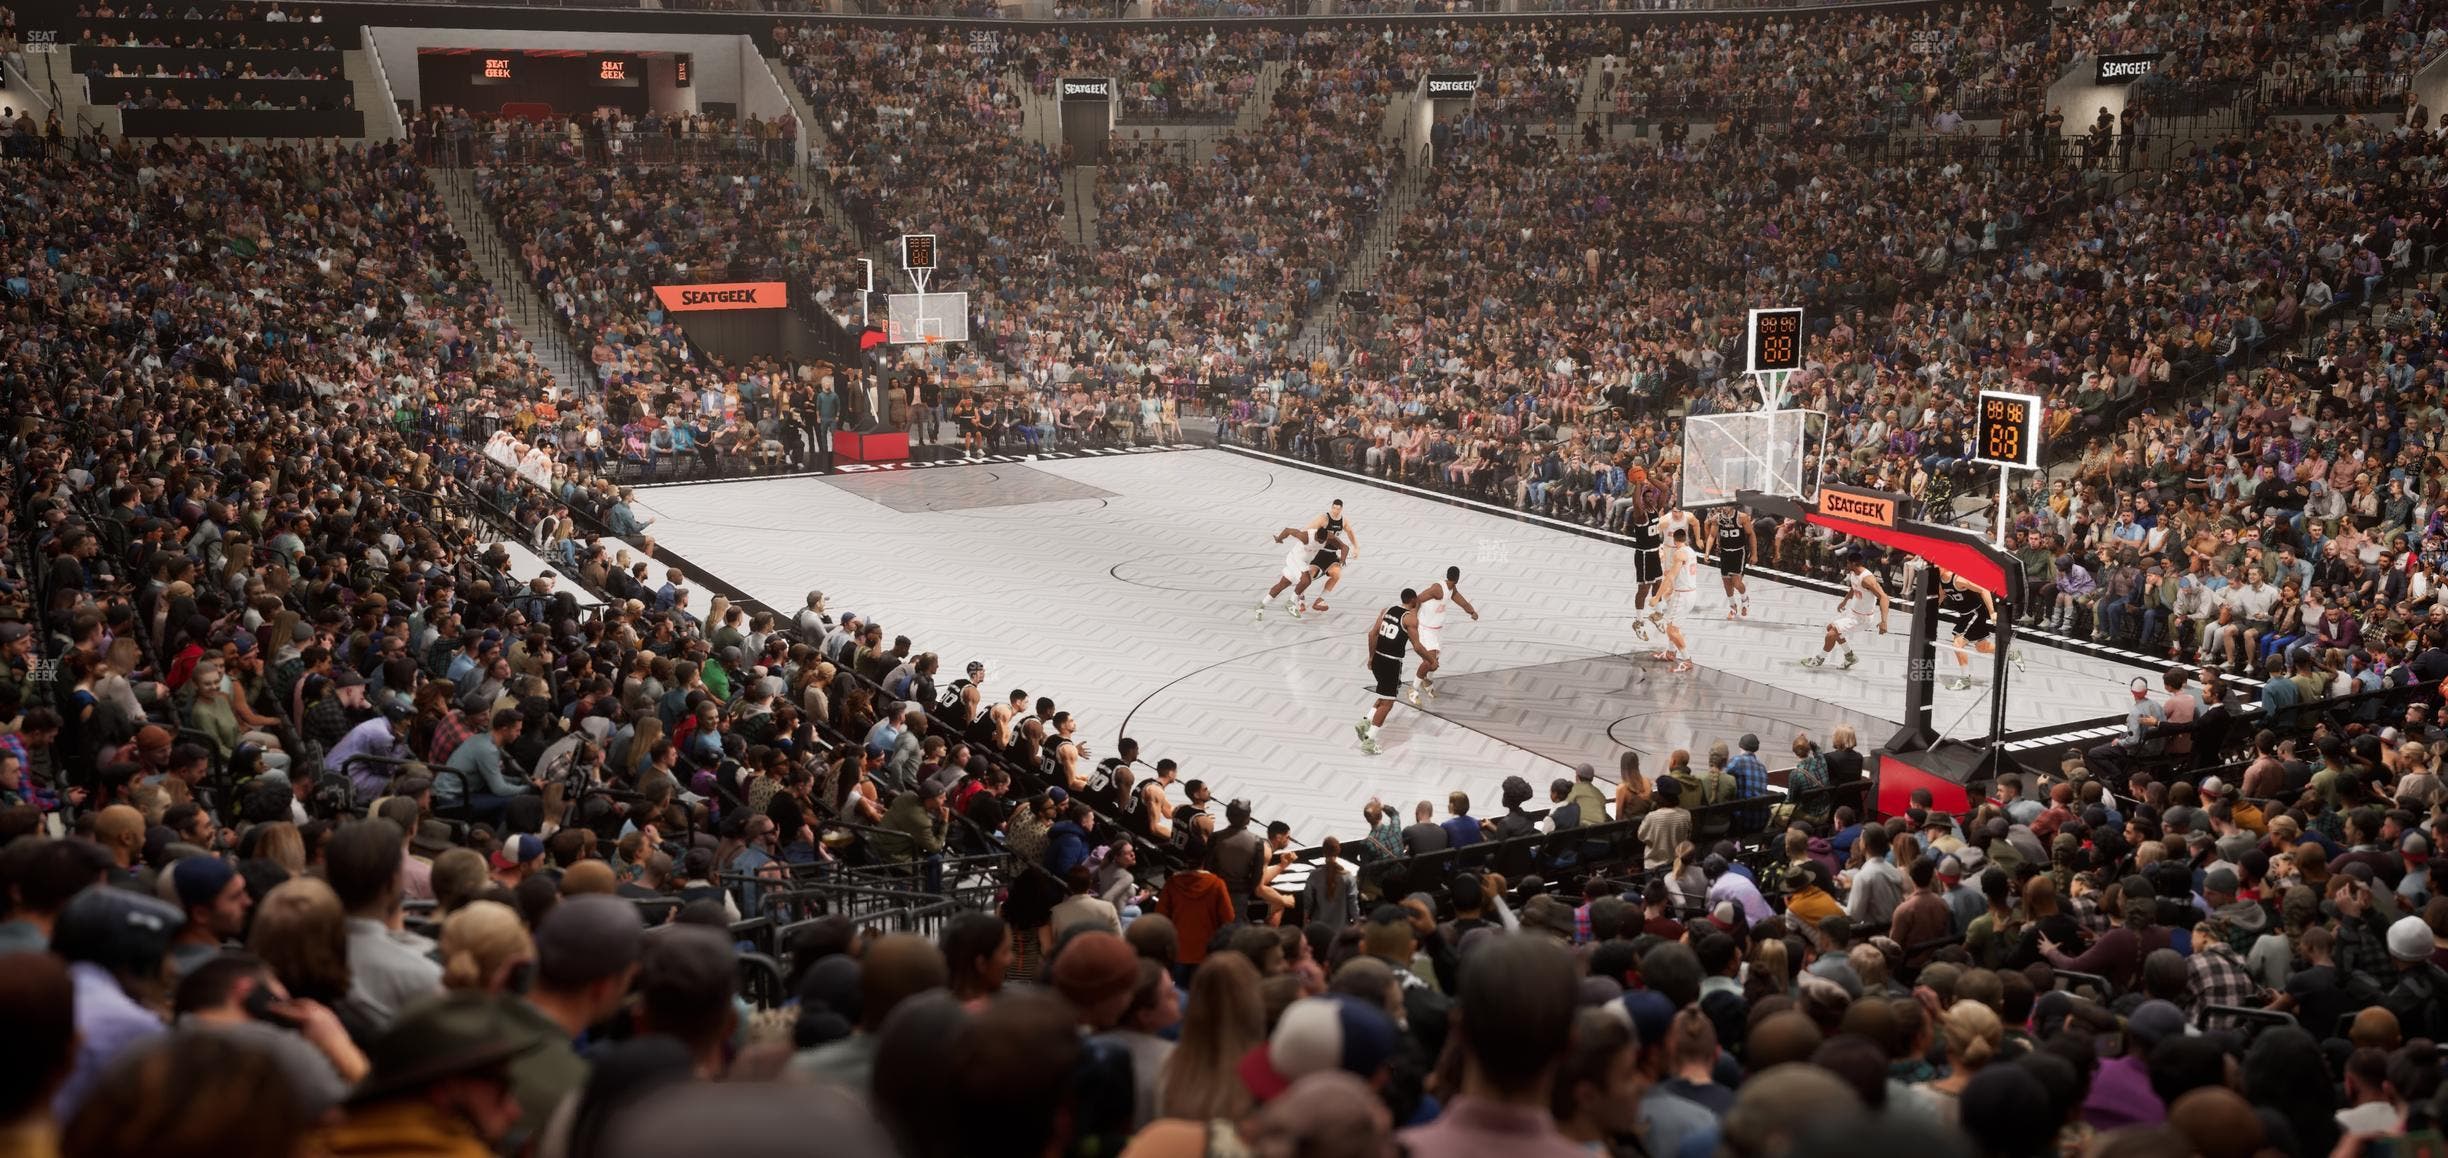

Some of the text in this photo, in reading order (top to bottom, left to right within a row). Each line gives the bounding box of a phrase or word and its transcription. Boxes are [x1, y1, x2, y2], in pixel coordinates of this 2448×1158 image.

[486, 59, 510, 69] SEAT
[602, 61, 624, 70] SEAT
[485, 69, 511, 78] GEEK
[600, 70, 625, 80] GEEK
[1064, 83, 1108, 95] SEATGEEK
[681, 289, 757, 305] SEATGEEK
[1764, 336, 1791, 362] 88
[1990, 424, 2018, 458] 88
[1827, 494, 1885, 521] SEATGEEK
[1379, 621, 1399, 640] 00
